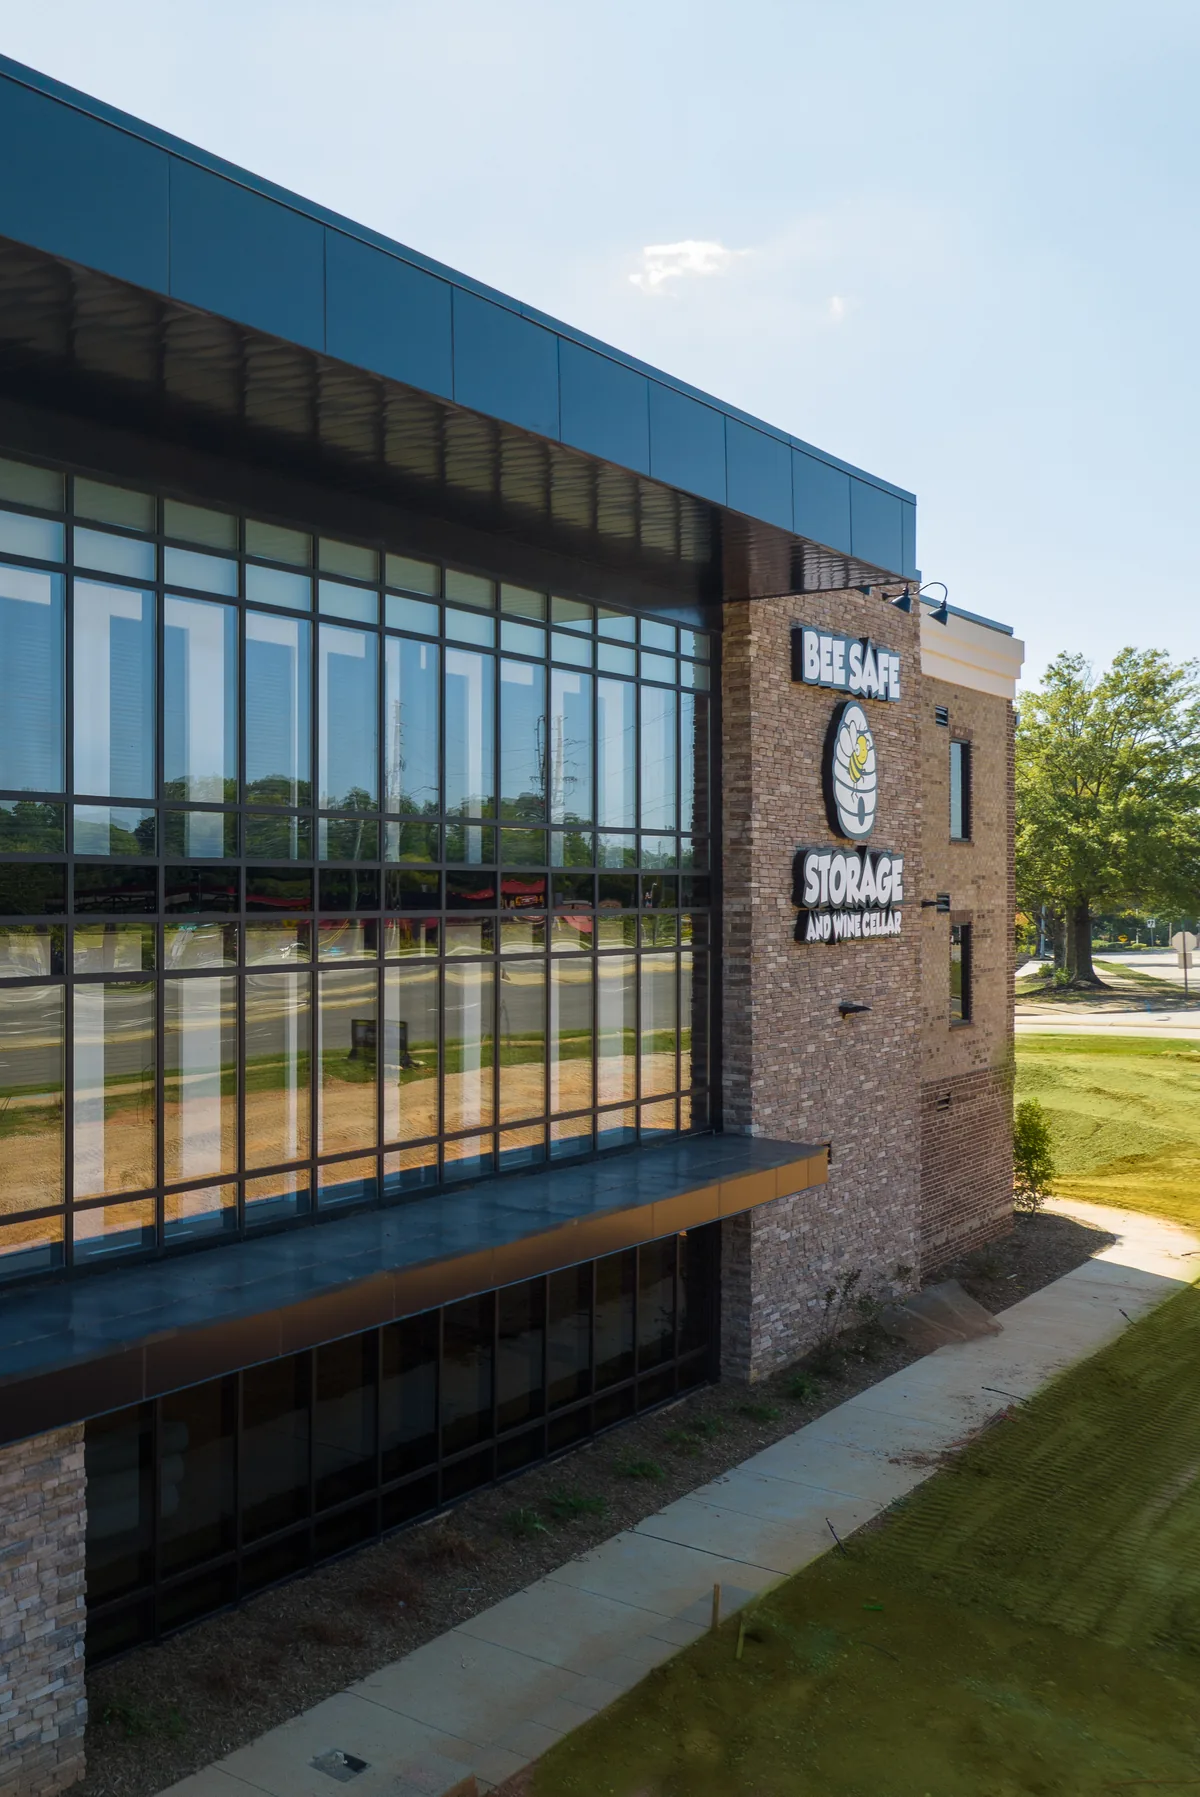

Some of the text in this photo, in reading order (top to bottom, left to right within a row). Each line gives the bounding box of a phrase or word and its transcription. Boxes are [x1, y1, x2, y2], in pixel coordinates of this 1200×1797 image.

[804, 631, 900, 699] BEE SAFE
[804, 854, 903, 905] STORAGE
[806, 910, 902, 942] AND WINE CELLAR
